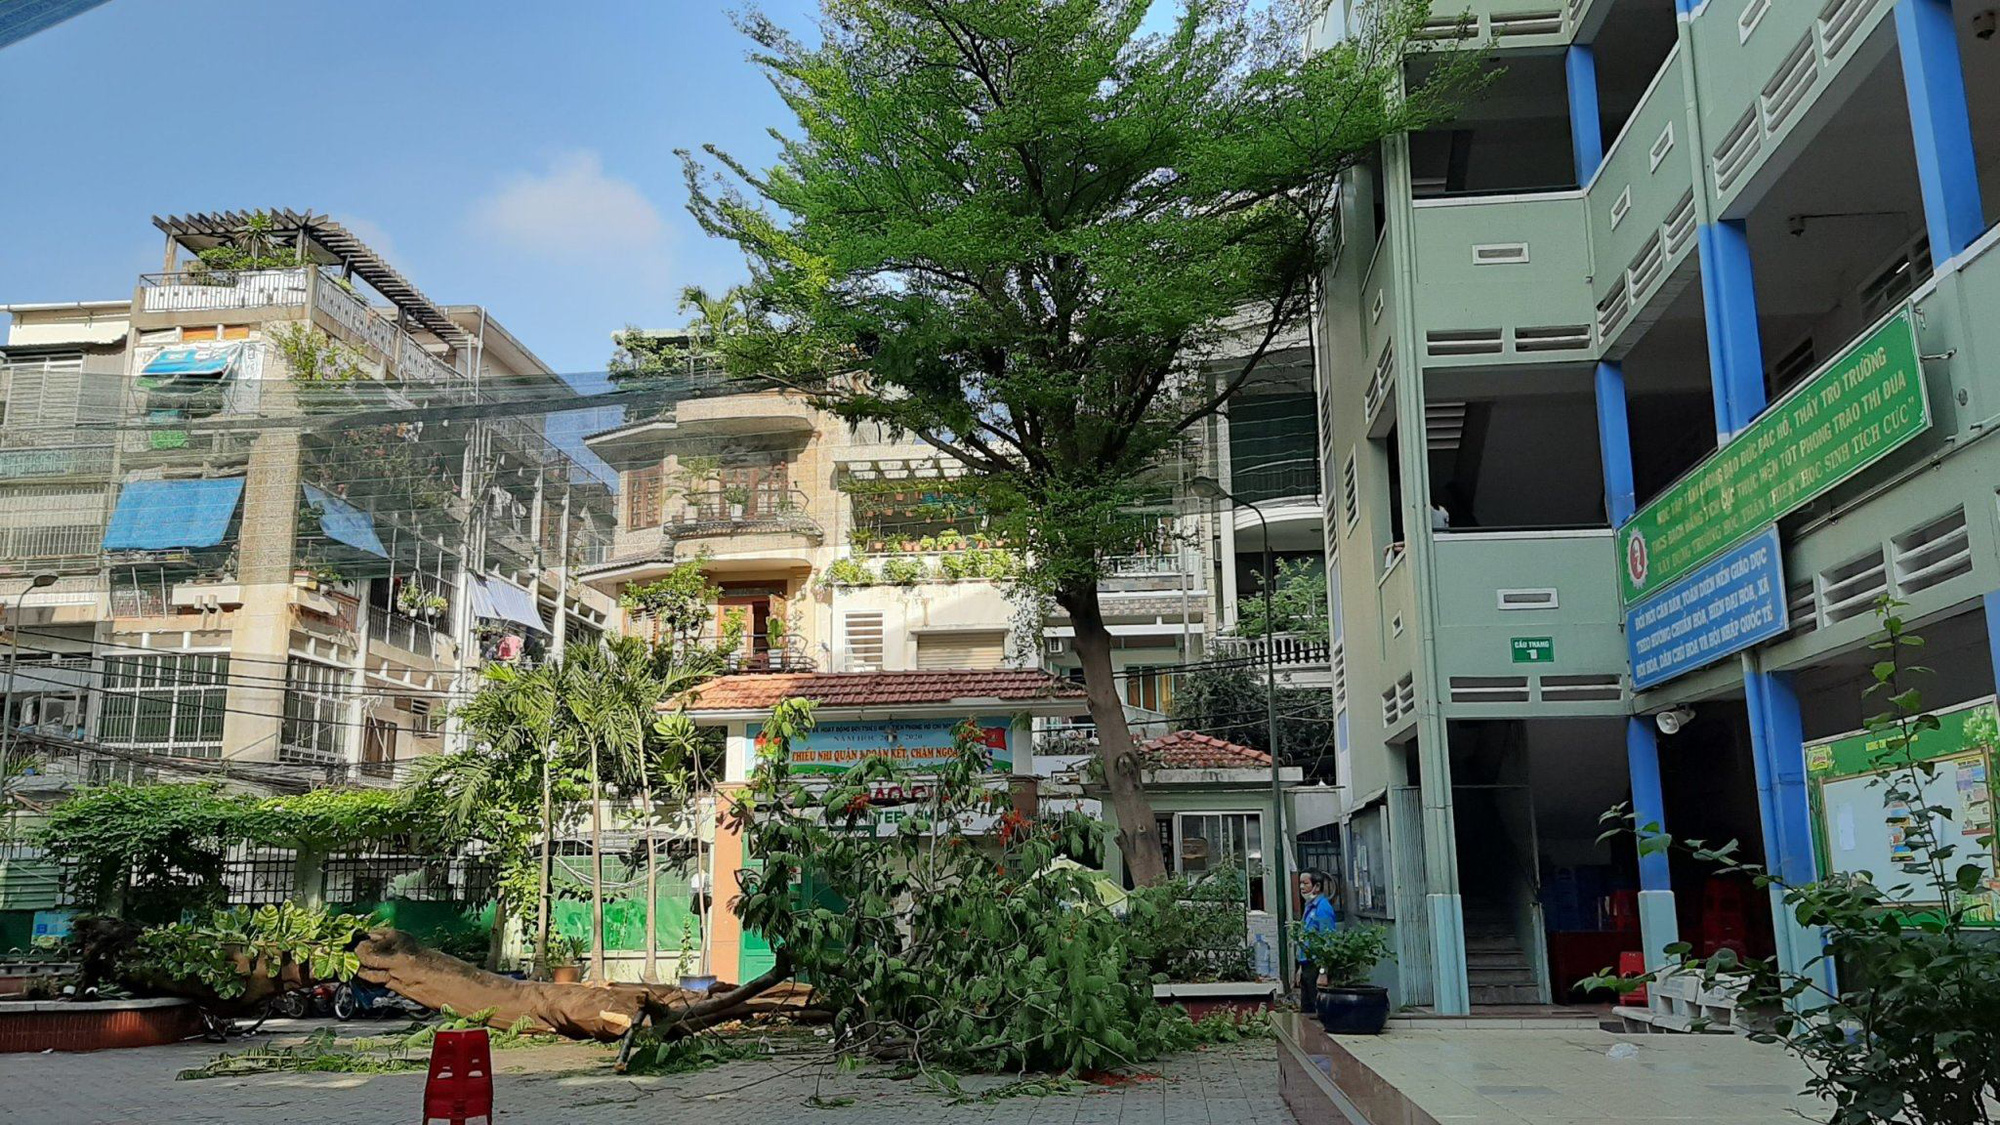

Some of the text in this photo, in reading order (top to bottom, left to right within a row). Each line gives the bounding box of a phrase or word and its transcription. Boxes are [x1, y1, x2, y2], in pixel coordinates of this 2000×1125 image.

[1820, 377, 1841, 408] TRÒ
[1842, 347, 1887, 391] TRƯỜNG
[1780, 442, 1797, 469] TỐT
[1800, 423, 1832, 458] PHONG
[1832, 402, 1860, 434] TRÀO
[1861, 387, 1881, 414] THI
[1882, 370, 1907, 400] ĐUA
[1824, 442, 1850, 472] SINH
[1851, 423, 1881, 454] TÍCH
[1740, 605, 1762, 633] QUỐC
[1761, 597, 1773, 623] TẾ
[1526, 649, 1537, 659] 1
[1528, 640, 1549, 648] THANG
